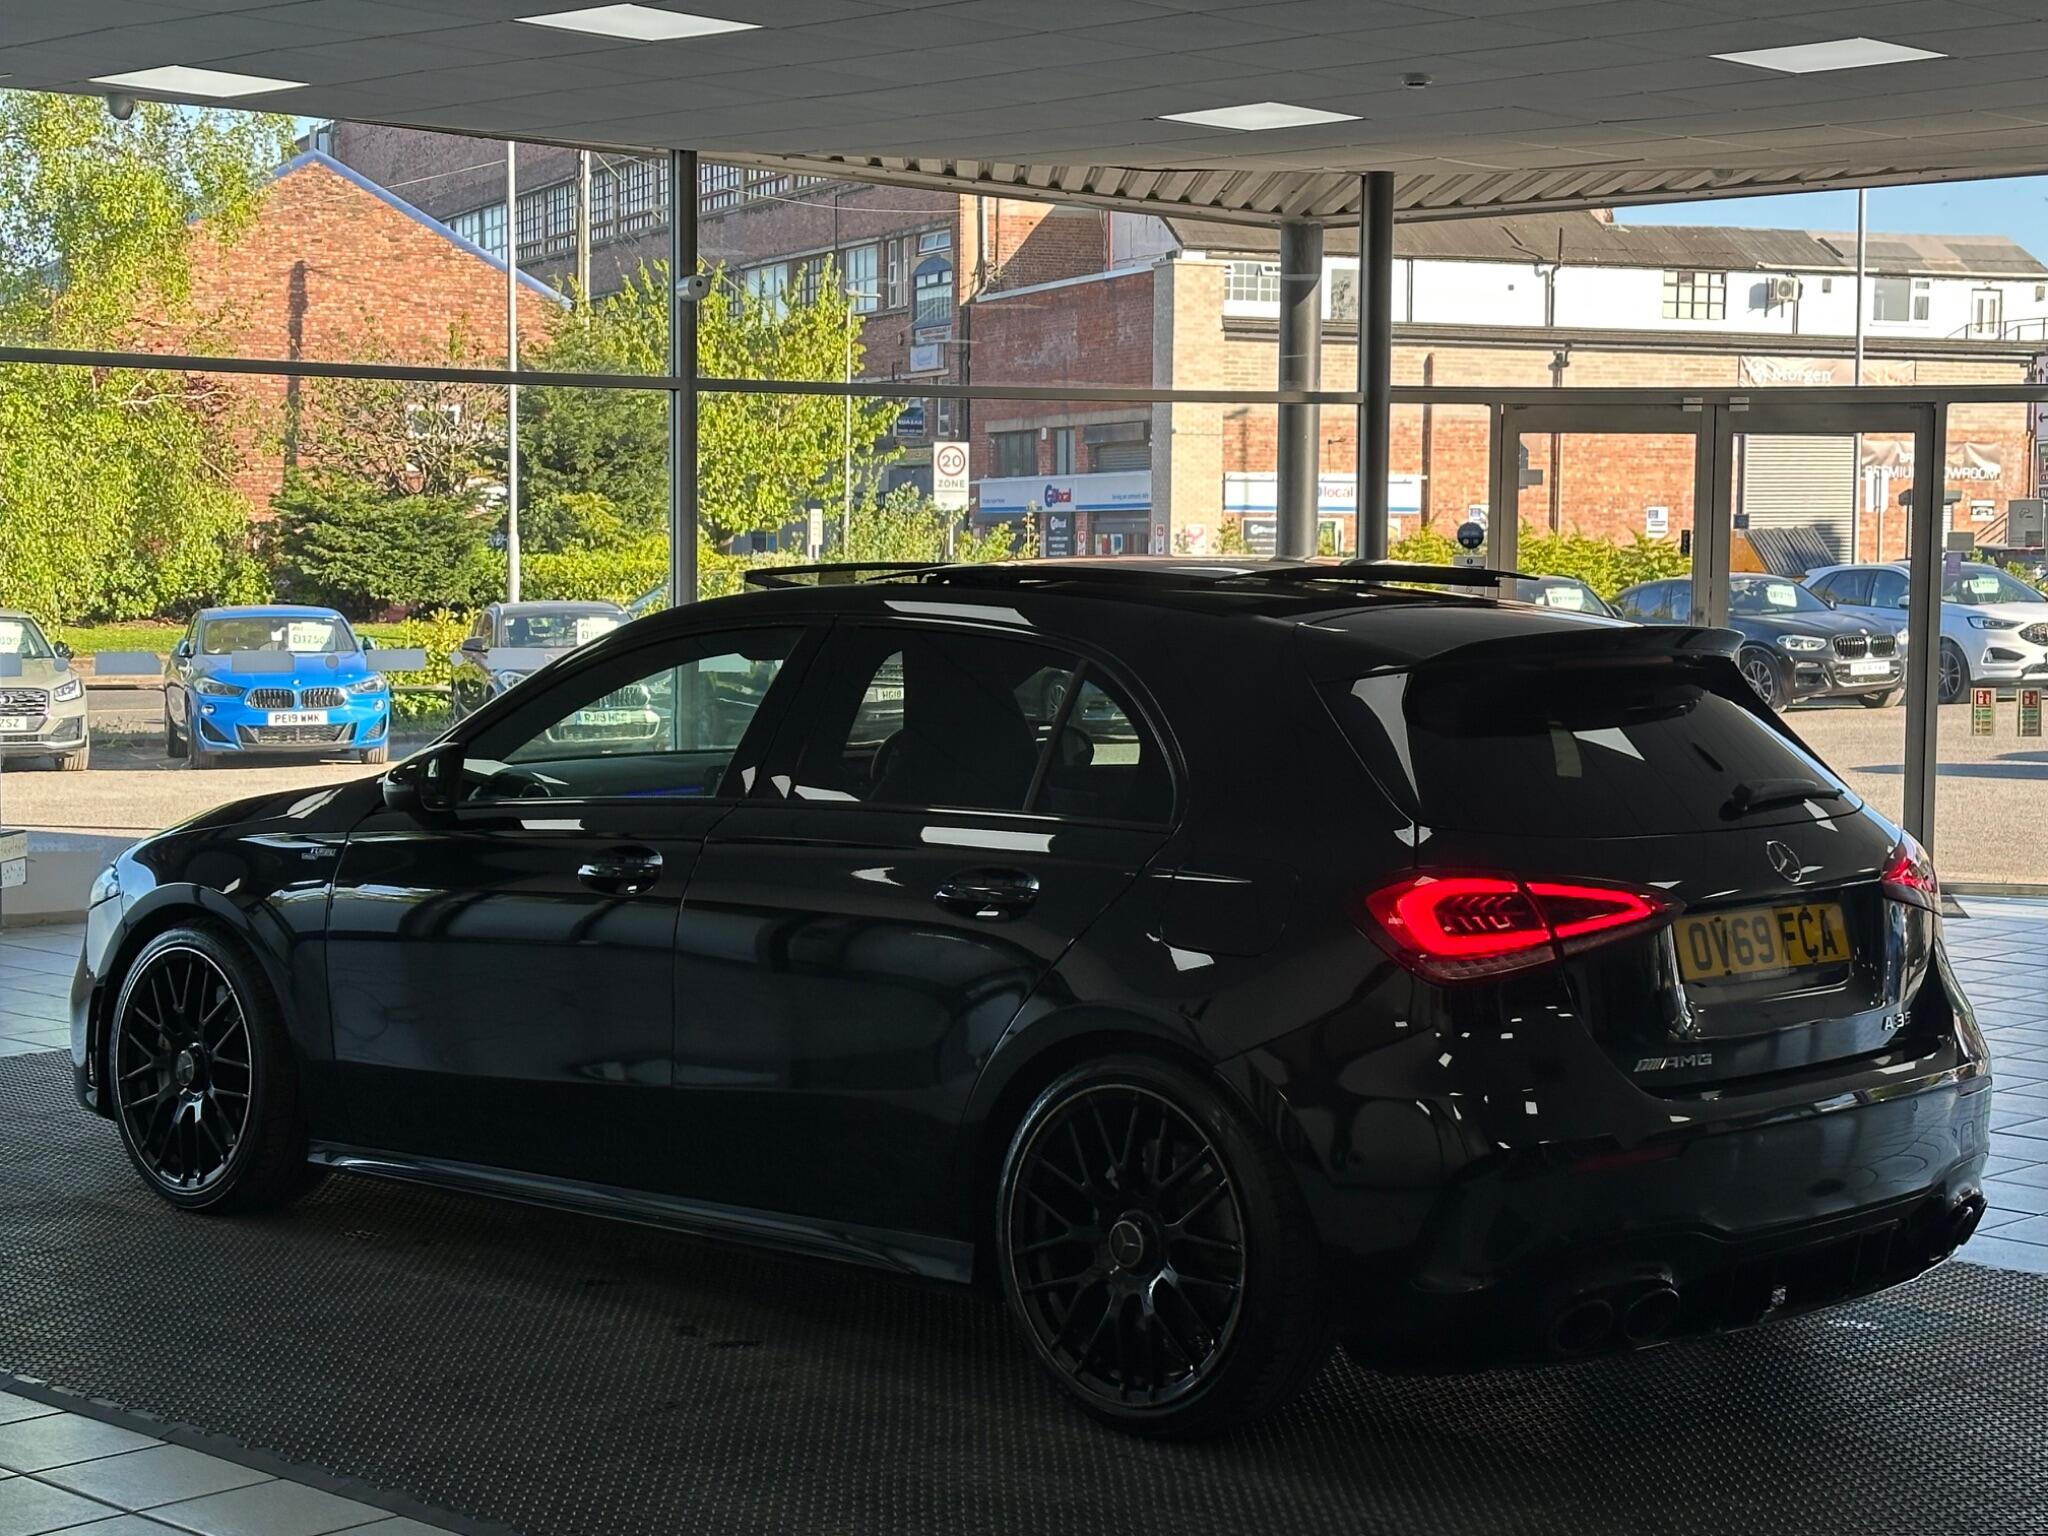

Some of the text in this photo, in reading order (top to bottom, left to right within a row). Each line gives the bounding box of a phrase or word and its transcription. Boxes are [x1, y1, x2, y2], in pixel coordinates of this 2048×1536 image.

[941, 454, 962, 468] 20
[937, 480, 966, 489] ZONE
[1323, 486, 1354, 498] local
[274, 713, 320, 723] PE19 WMK
[1688, 908, 1838, 971] OV69 FCA
[1661, 1054, 1712, 1069] AMG
